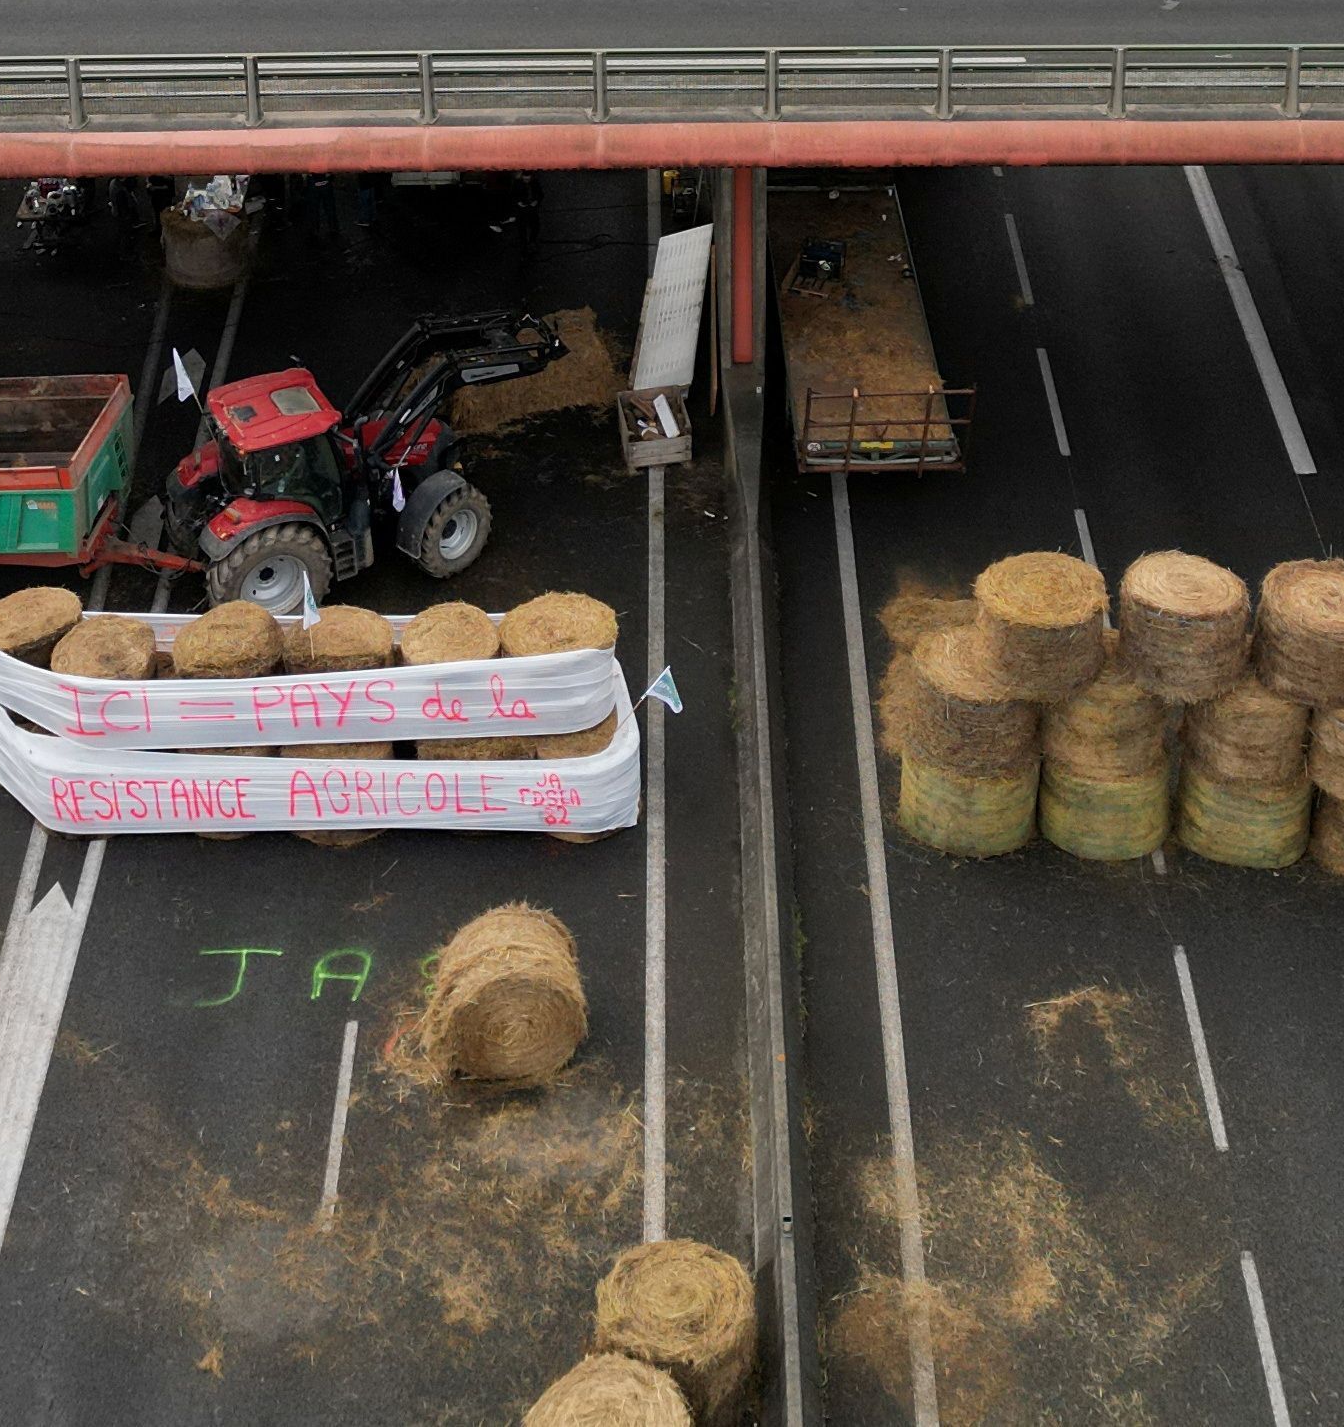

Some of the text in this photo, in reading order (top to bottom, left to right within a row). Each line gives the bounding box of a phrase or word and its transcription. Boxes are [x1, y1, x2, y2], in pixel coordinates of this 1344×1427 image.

[58, 684, 152, 737] ICI
[250, 680, 398, 733] PAYS
[421, 685, 470, 724] de
[488, 673, 539, 721] la
[50, 768, 507, 825] RESISTANCE AGRICOLE
